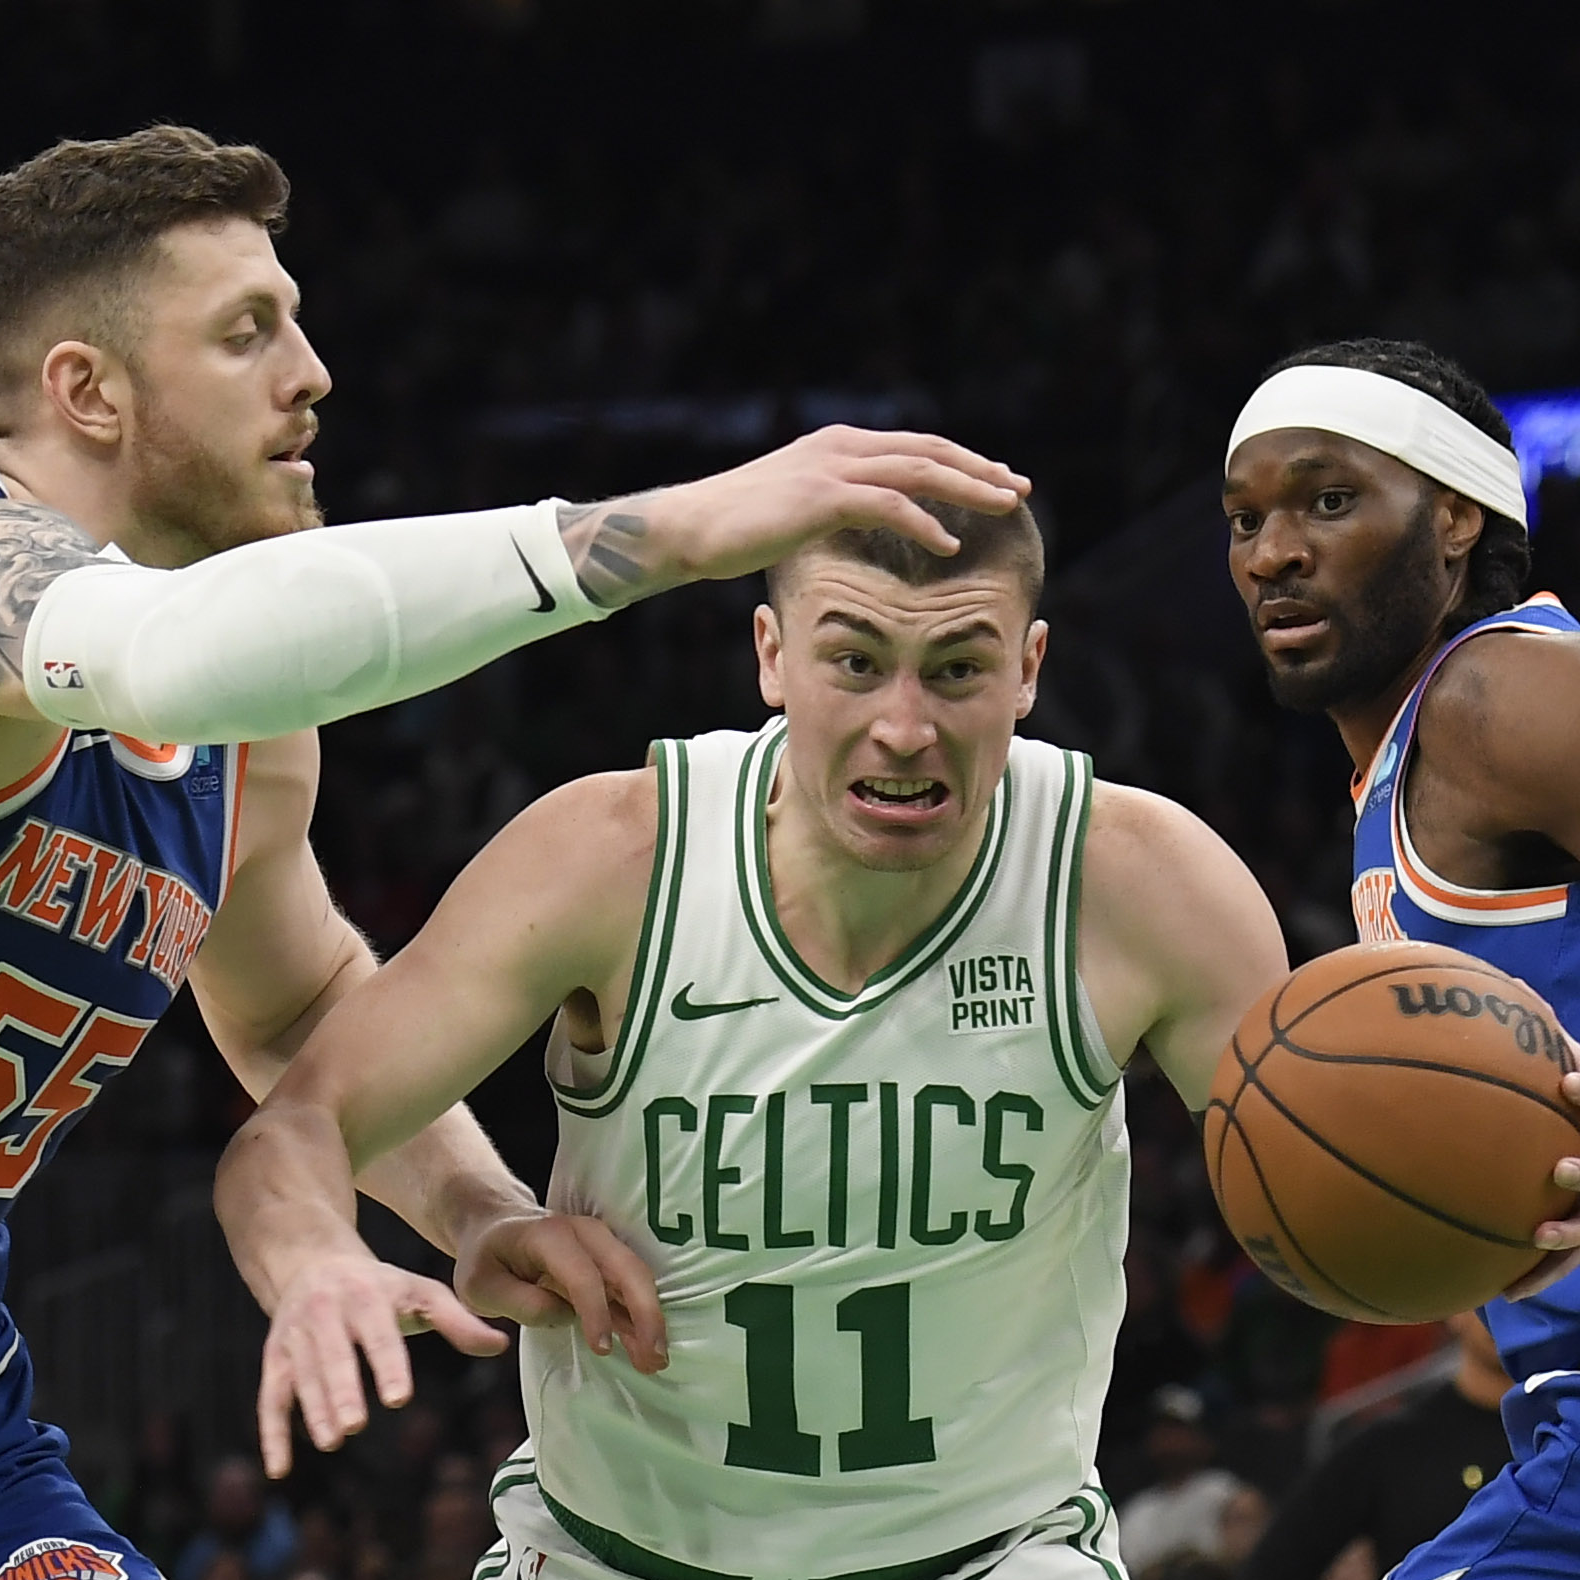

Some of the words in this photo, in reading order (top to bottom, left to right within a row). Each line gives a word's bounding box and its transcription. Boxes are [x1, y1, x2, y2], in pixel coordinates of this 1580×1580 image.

[125, 868, 213, 998] YORK
[948, 954, 1035, 999] VISTA
[952, 996, 1035, 1030] PRINT
[642, 1082, 1044, 1251] CELTICS
[724, 1282, 936, 1477] 11
[13, 1546, 35, 1566] NEW
[36, 1540, 68, 1554] YORK
